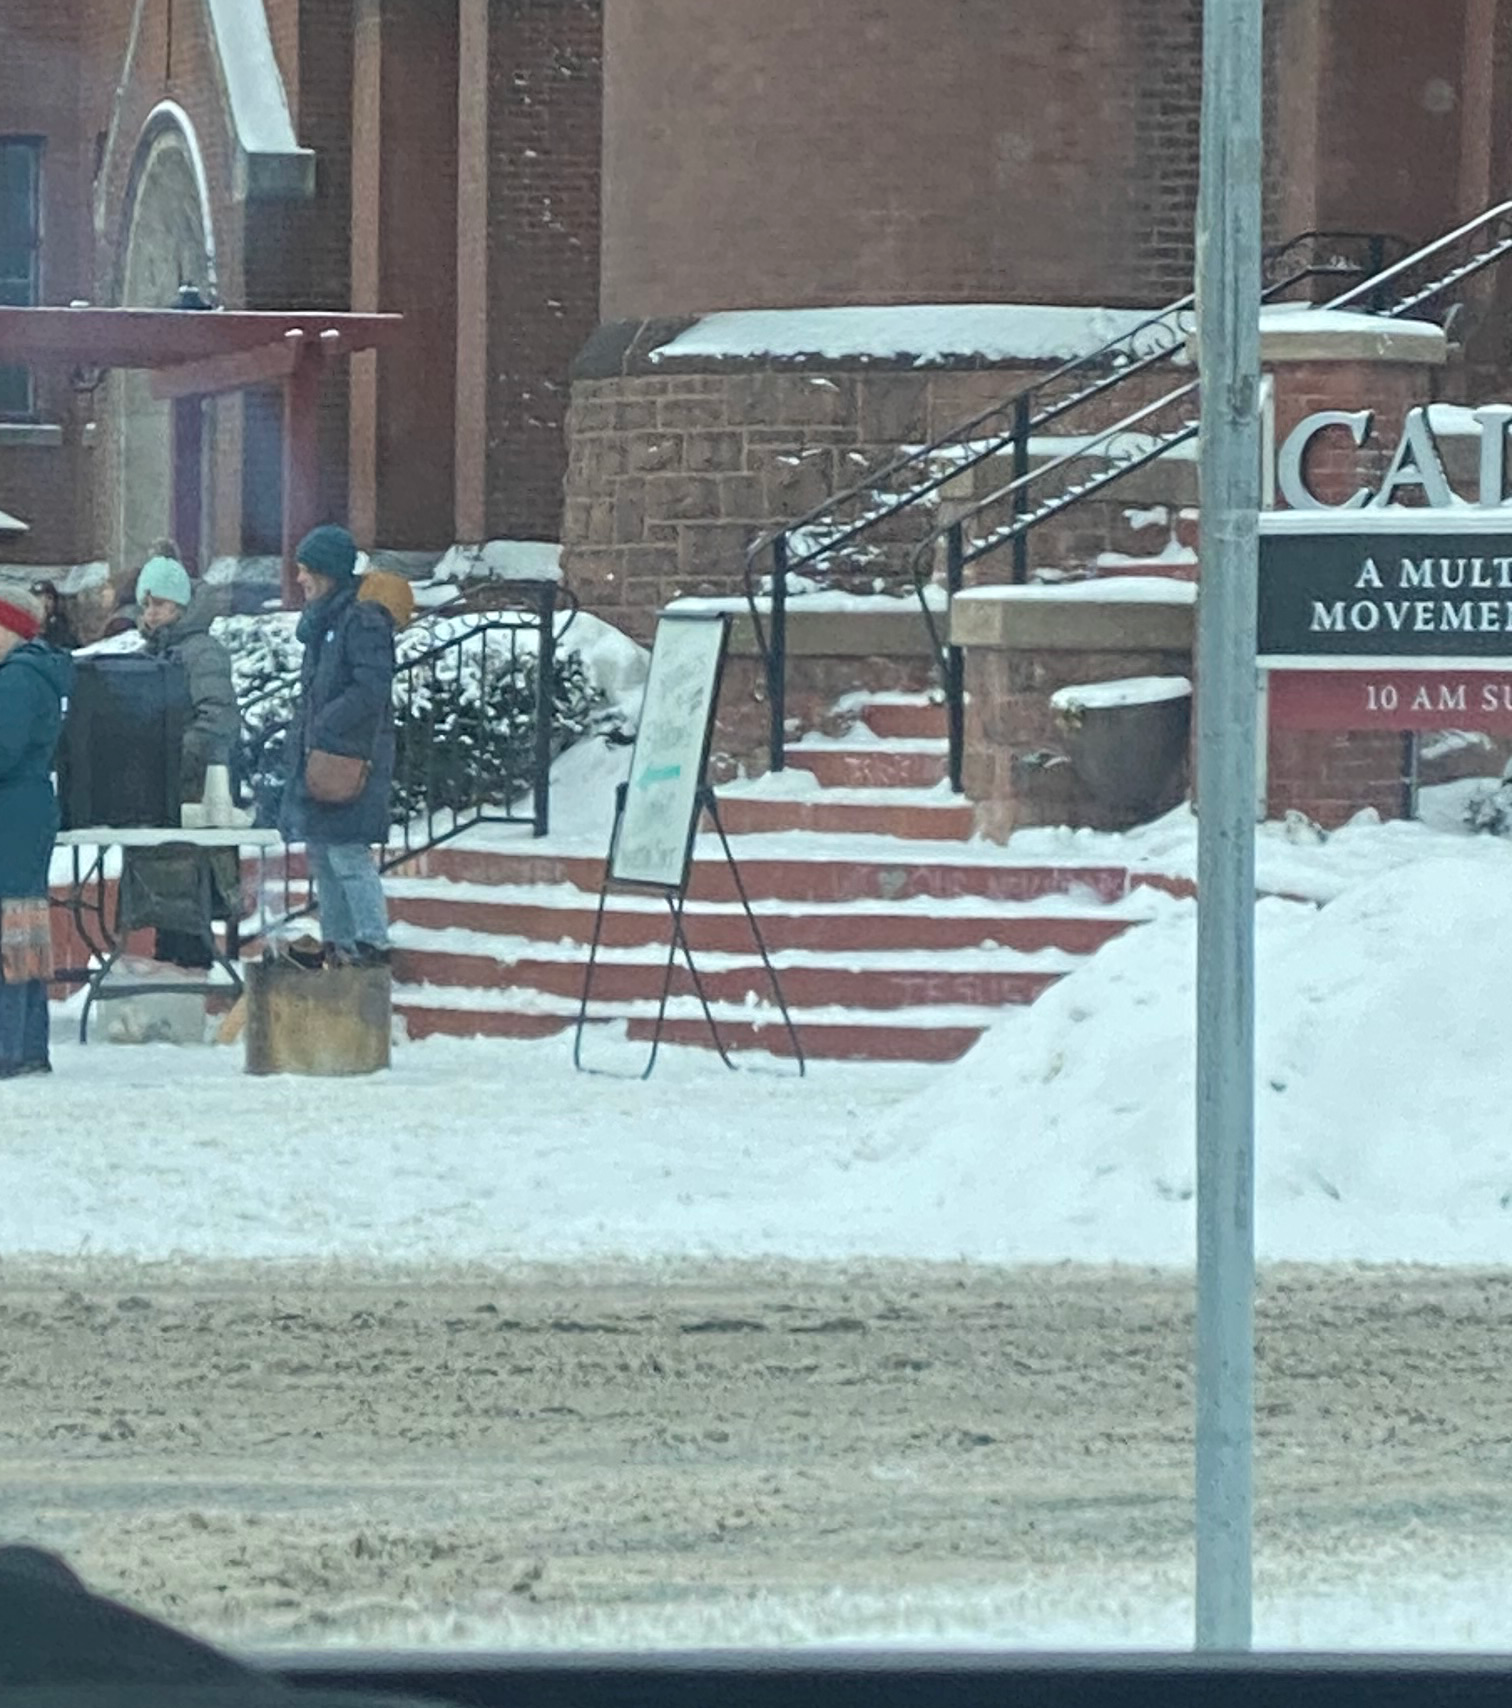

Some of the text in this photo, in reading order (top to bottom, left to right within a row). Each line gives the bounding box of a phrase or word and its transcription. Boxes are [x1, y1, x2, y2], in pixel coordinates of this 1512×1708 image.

[1354, 557, 1512, 589] A MULT
[1309, 600, 1512, 632] MOVEME
[1366, 684, 1398, 711] 10
[1410, 684, 1467, 711] AM
